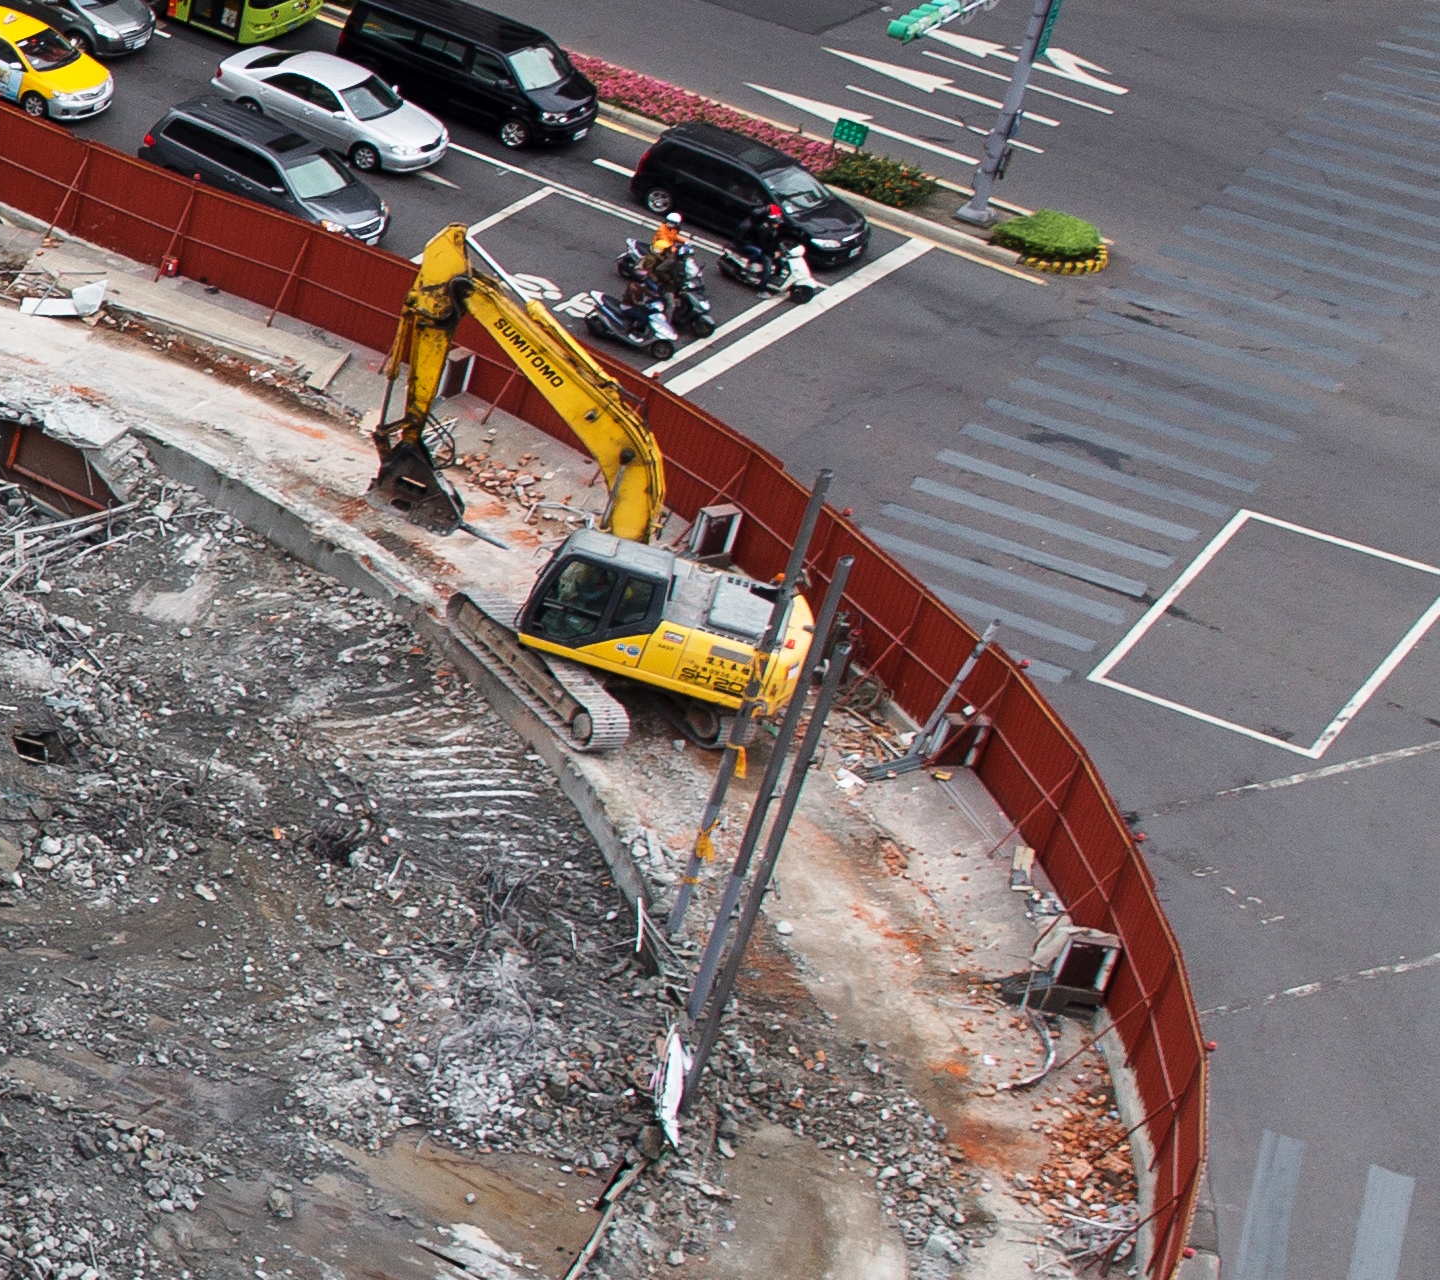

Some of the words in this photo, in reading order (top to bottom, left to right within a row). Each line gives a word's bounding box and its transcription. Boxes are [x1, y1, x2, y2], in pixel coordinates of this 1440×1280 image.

[492, 317, 564, 389] SUMITOMO
[681, 666, 712, 685] SH
[712, 676, 745, 695] 20
